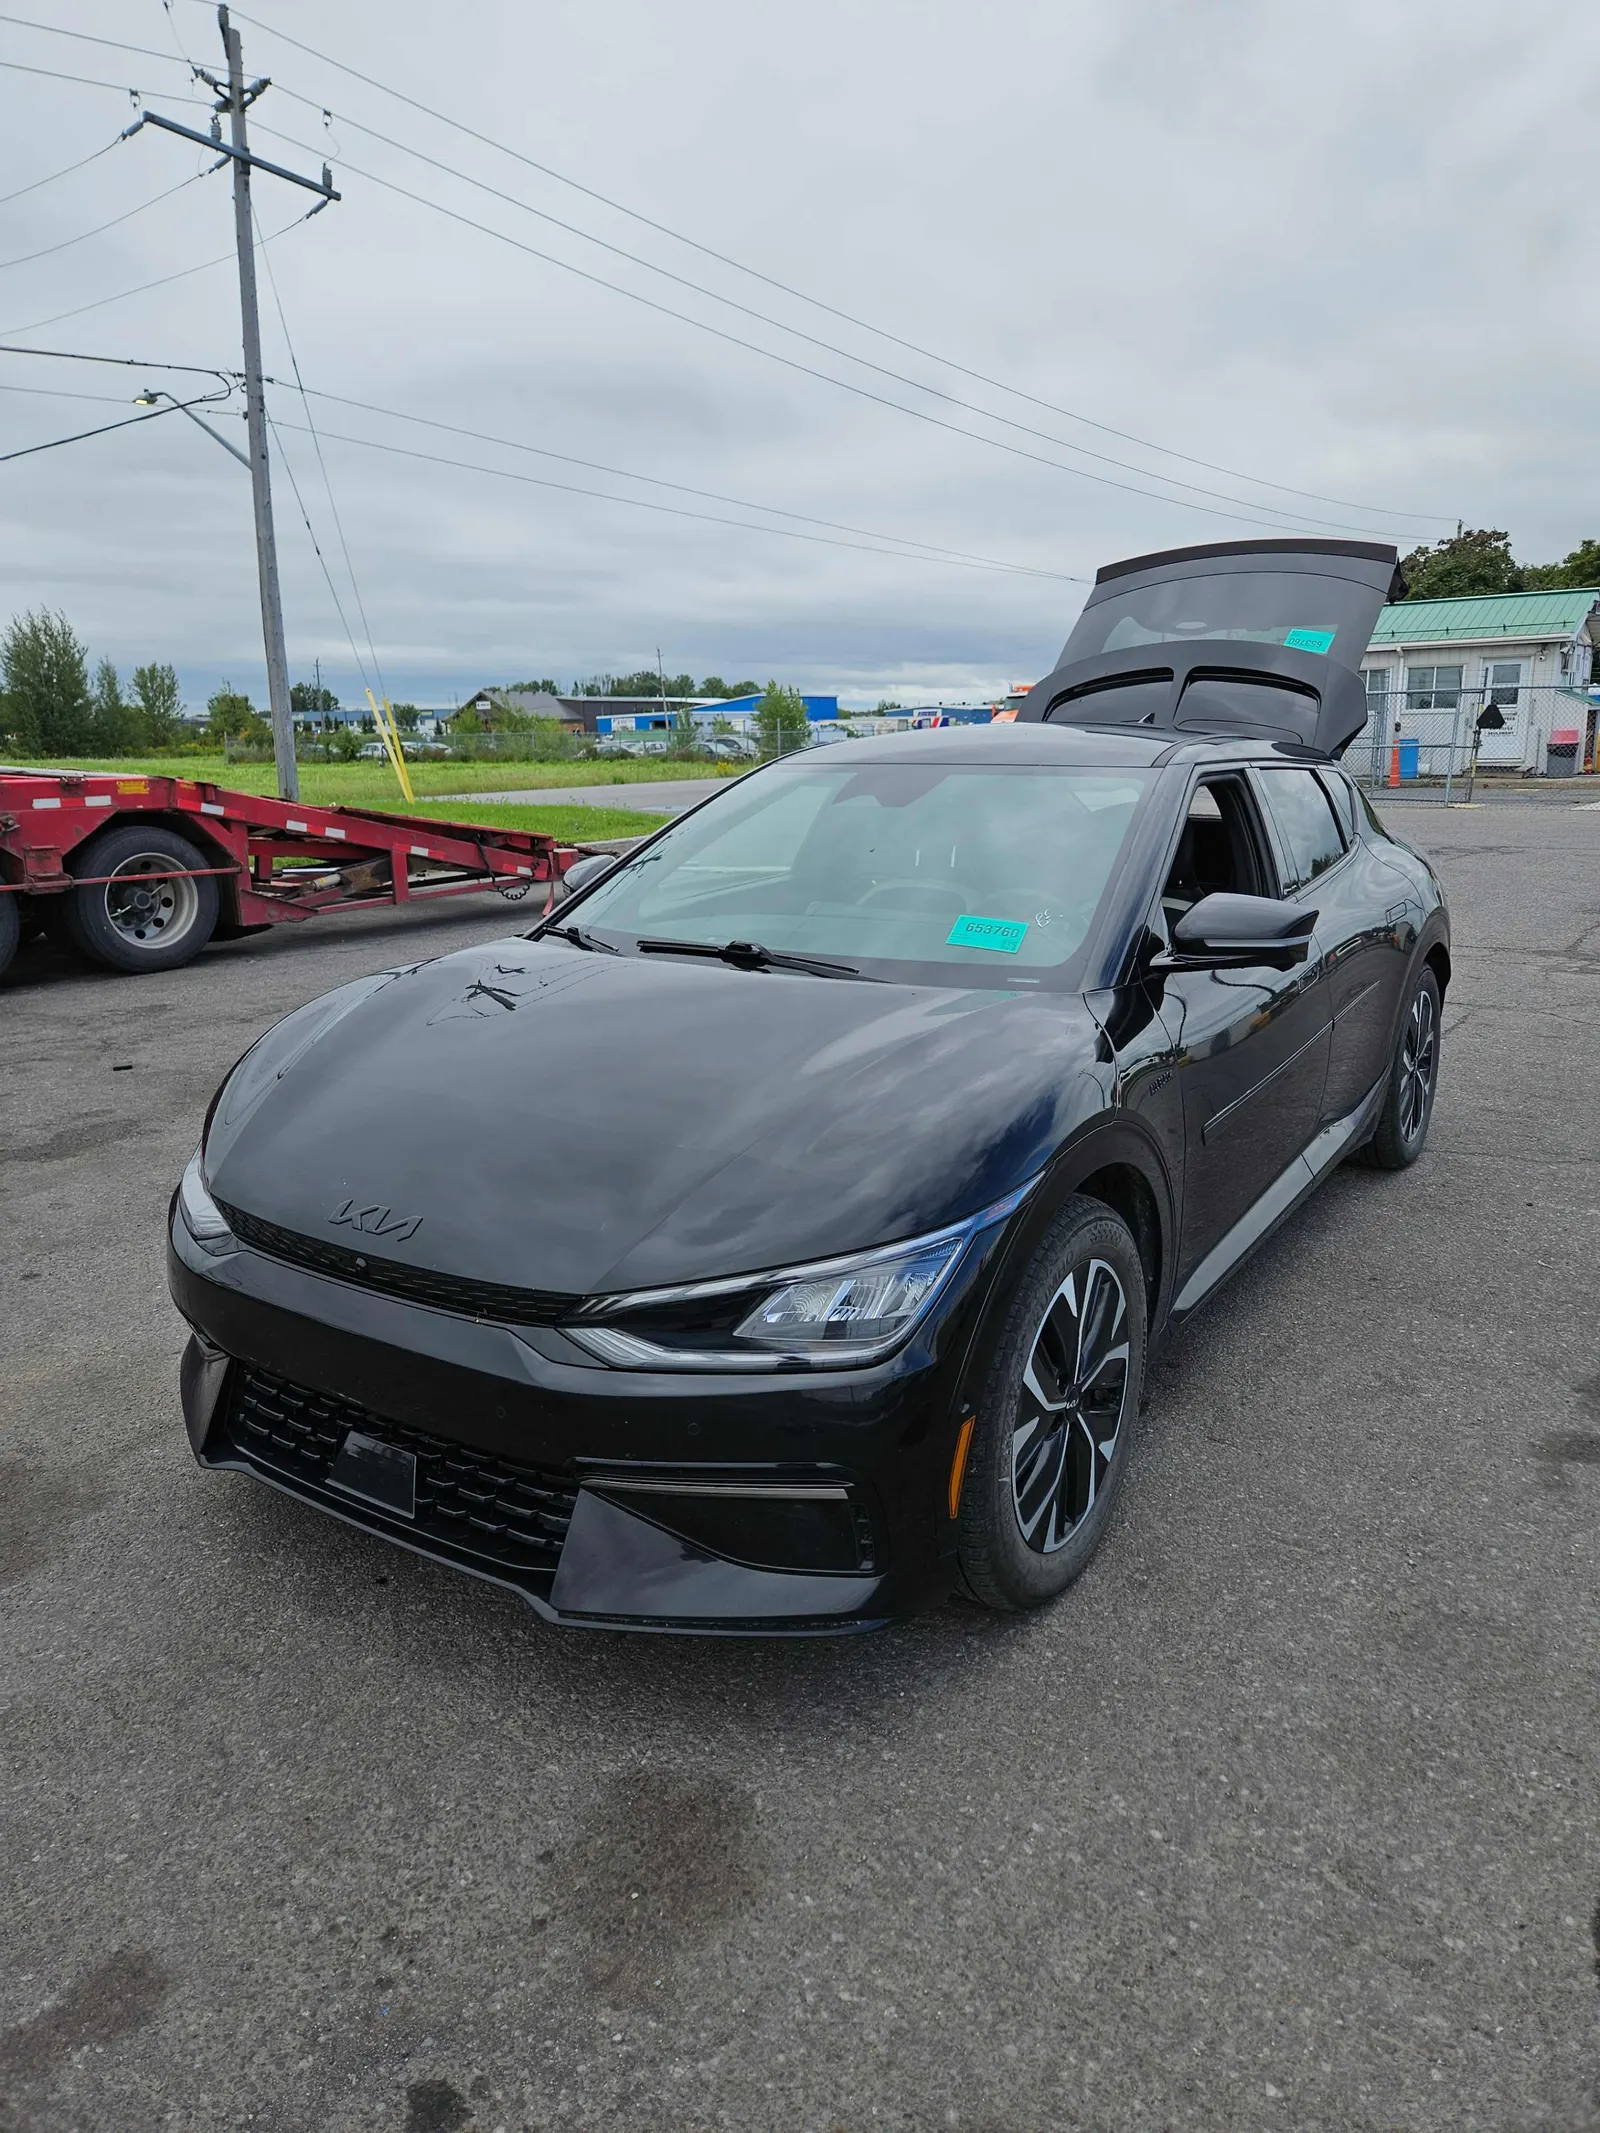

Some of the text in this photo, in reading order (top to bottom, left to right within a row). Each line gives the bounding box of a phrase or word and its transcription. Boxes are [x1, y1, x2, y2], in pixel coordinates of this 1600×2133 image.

[1288, 637, 1323, 648] 653760
[965, 922, 1019, 938] 653760
[328, 1199, 424, 1242] KIA
